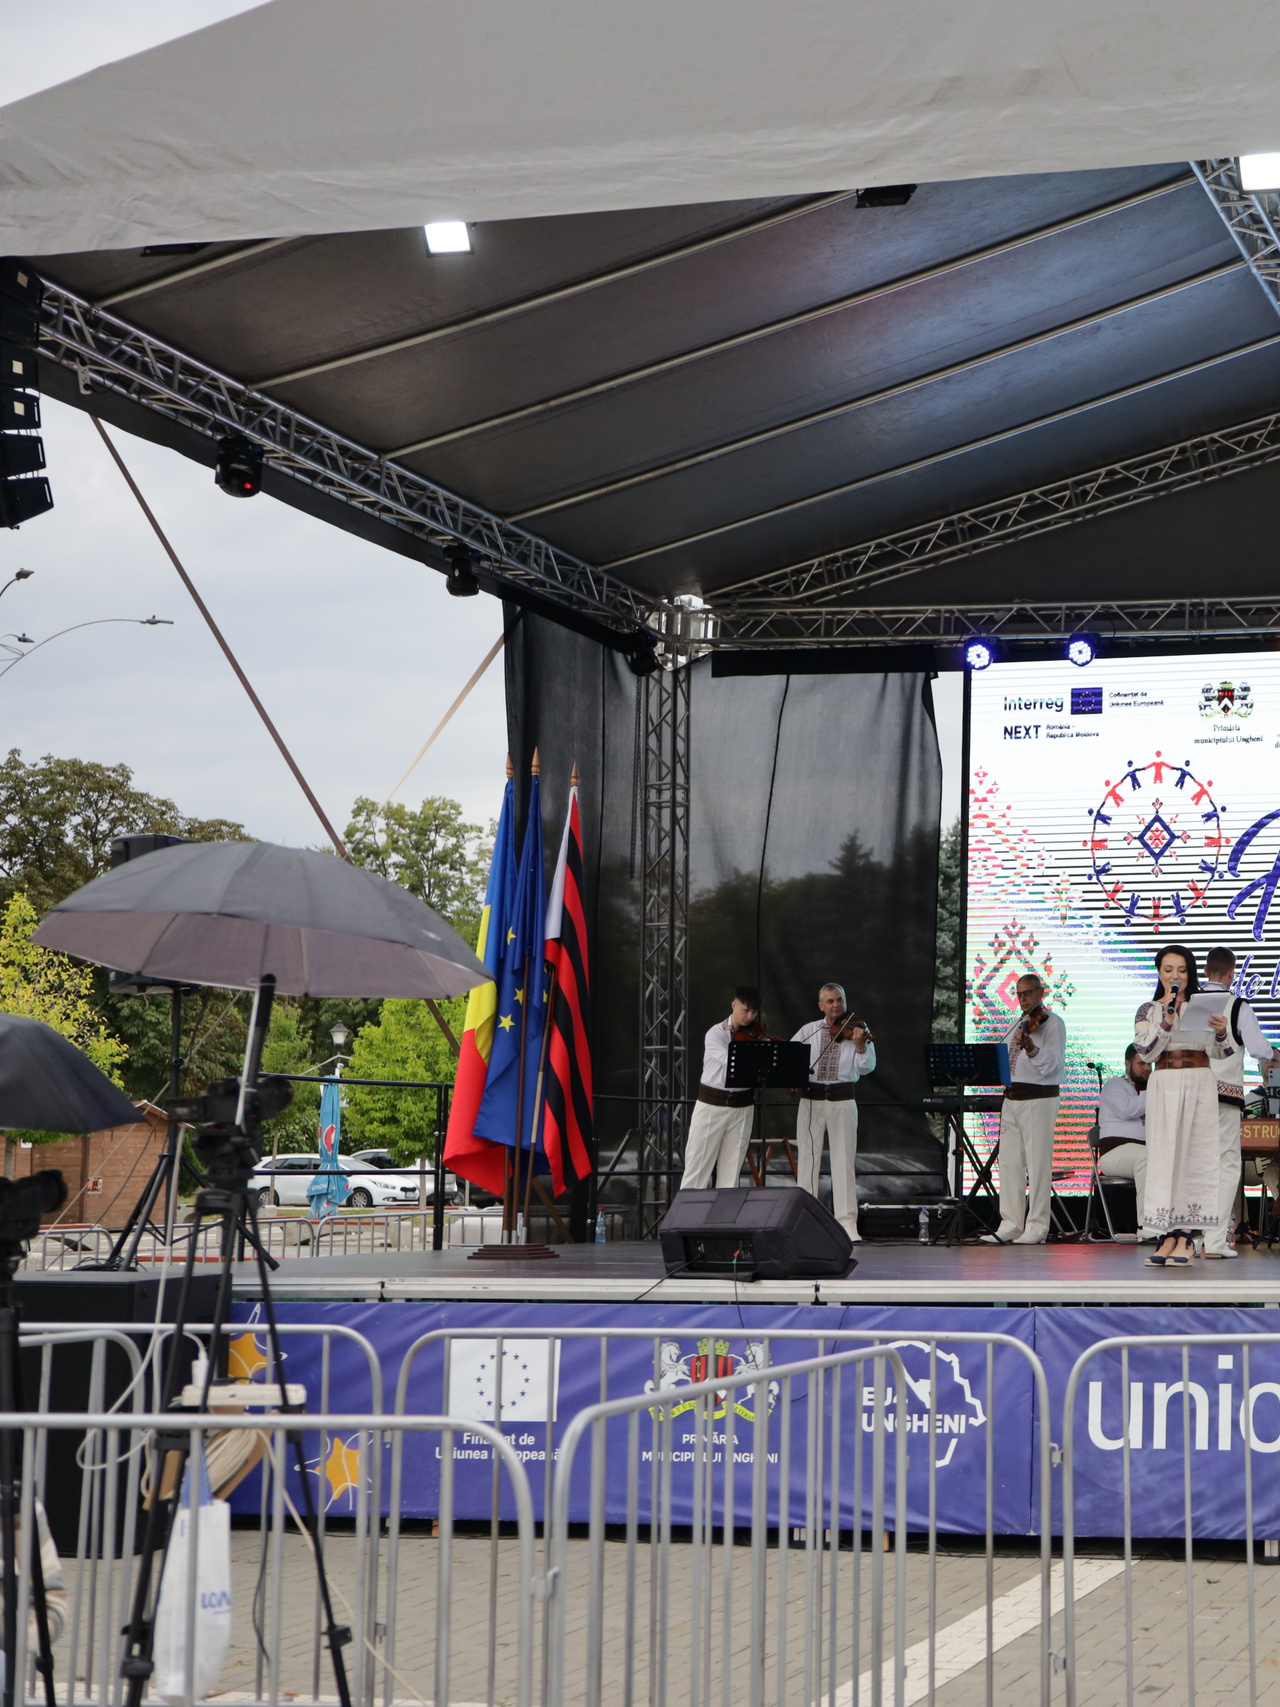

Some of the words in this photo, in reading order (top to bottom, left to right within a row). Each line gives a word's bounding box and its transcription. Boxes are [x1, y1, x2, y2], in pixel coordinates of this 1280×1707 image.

[1003, 725, 1041, 739] NEXT
[1236, 735, 1264, 744] Ungheni
[1229, 954, 1265, 999] de
[463, 1432, 516, 1445] Finaat
[519, 1433, 535, 1445] de
[682, 1432, 739, 1445] PRĂRA
[435, 1447, 488, 1459] Uiunea
